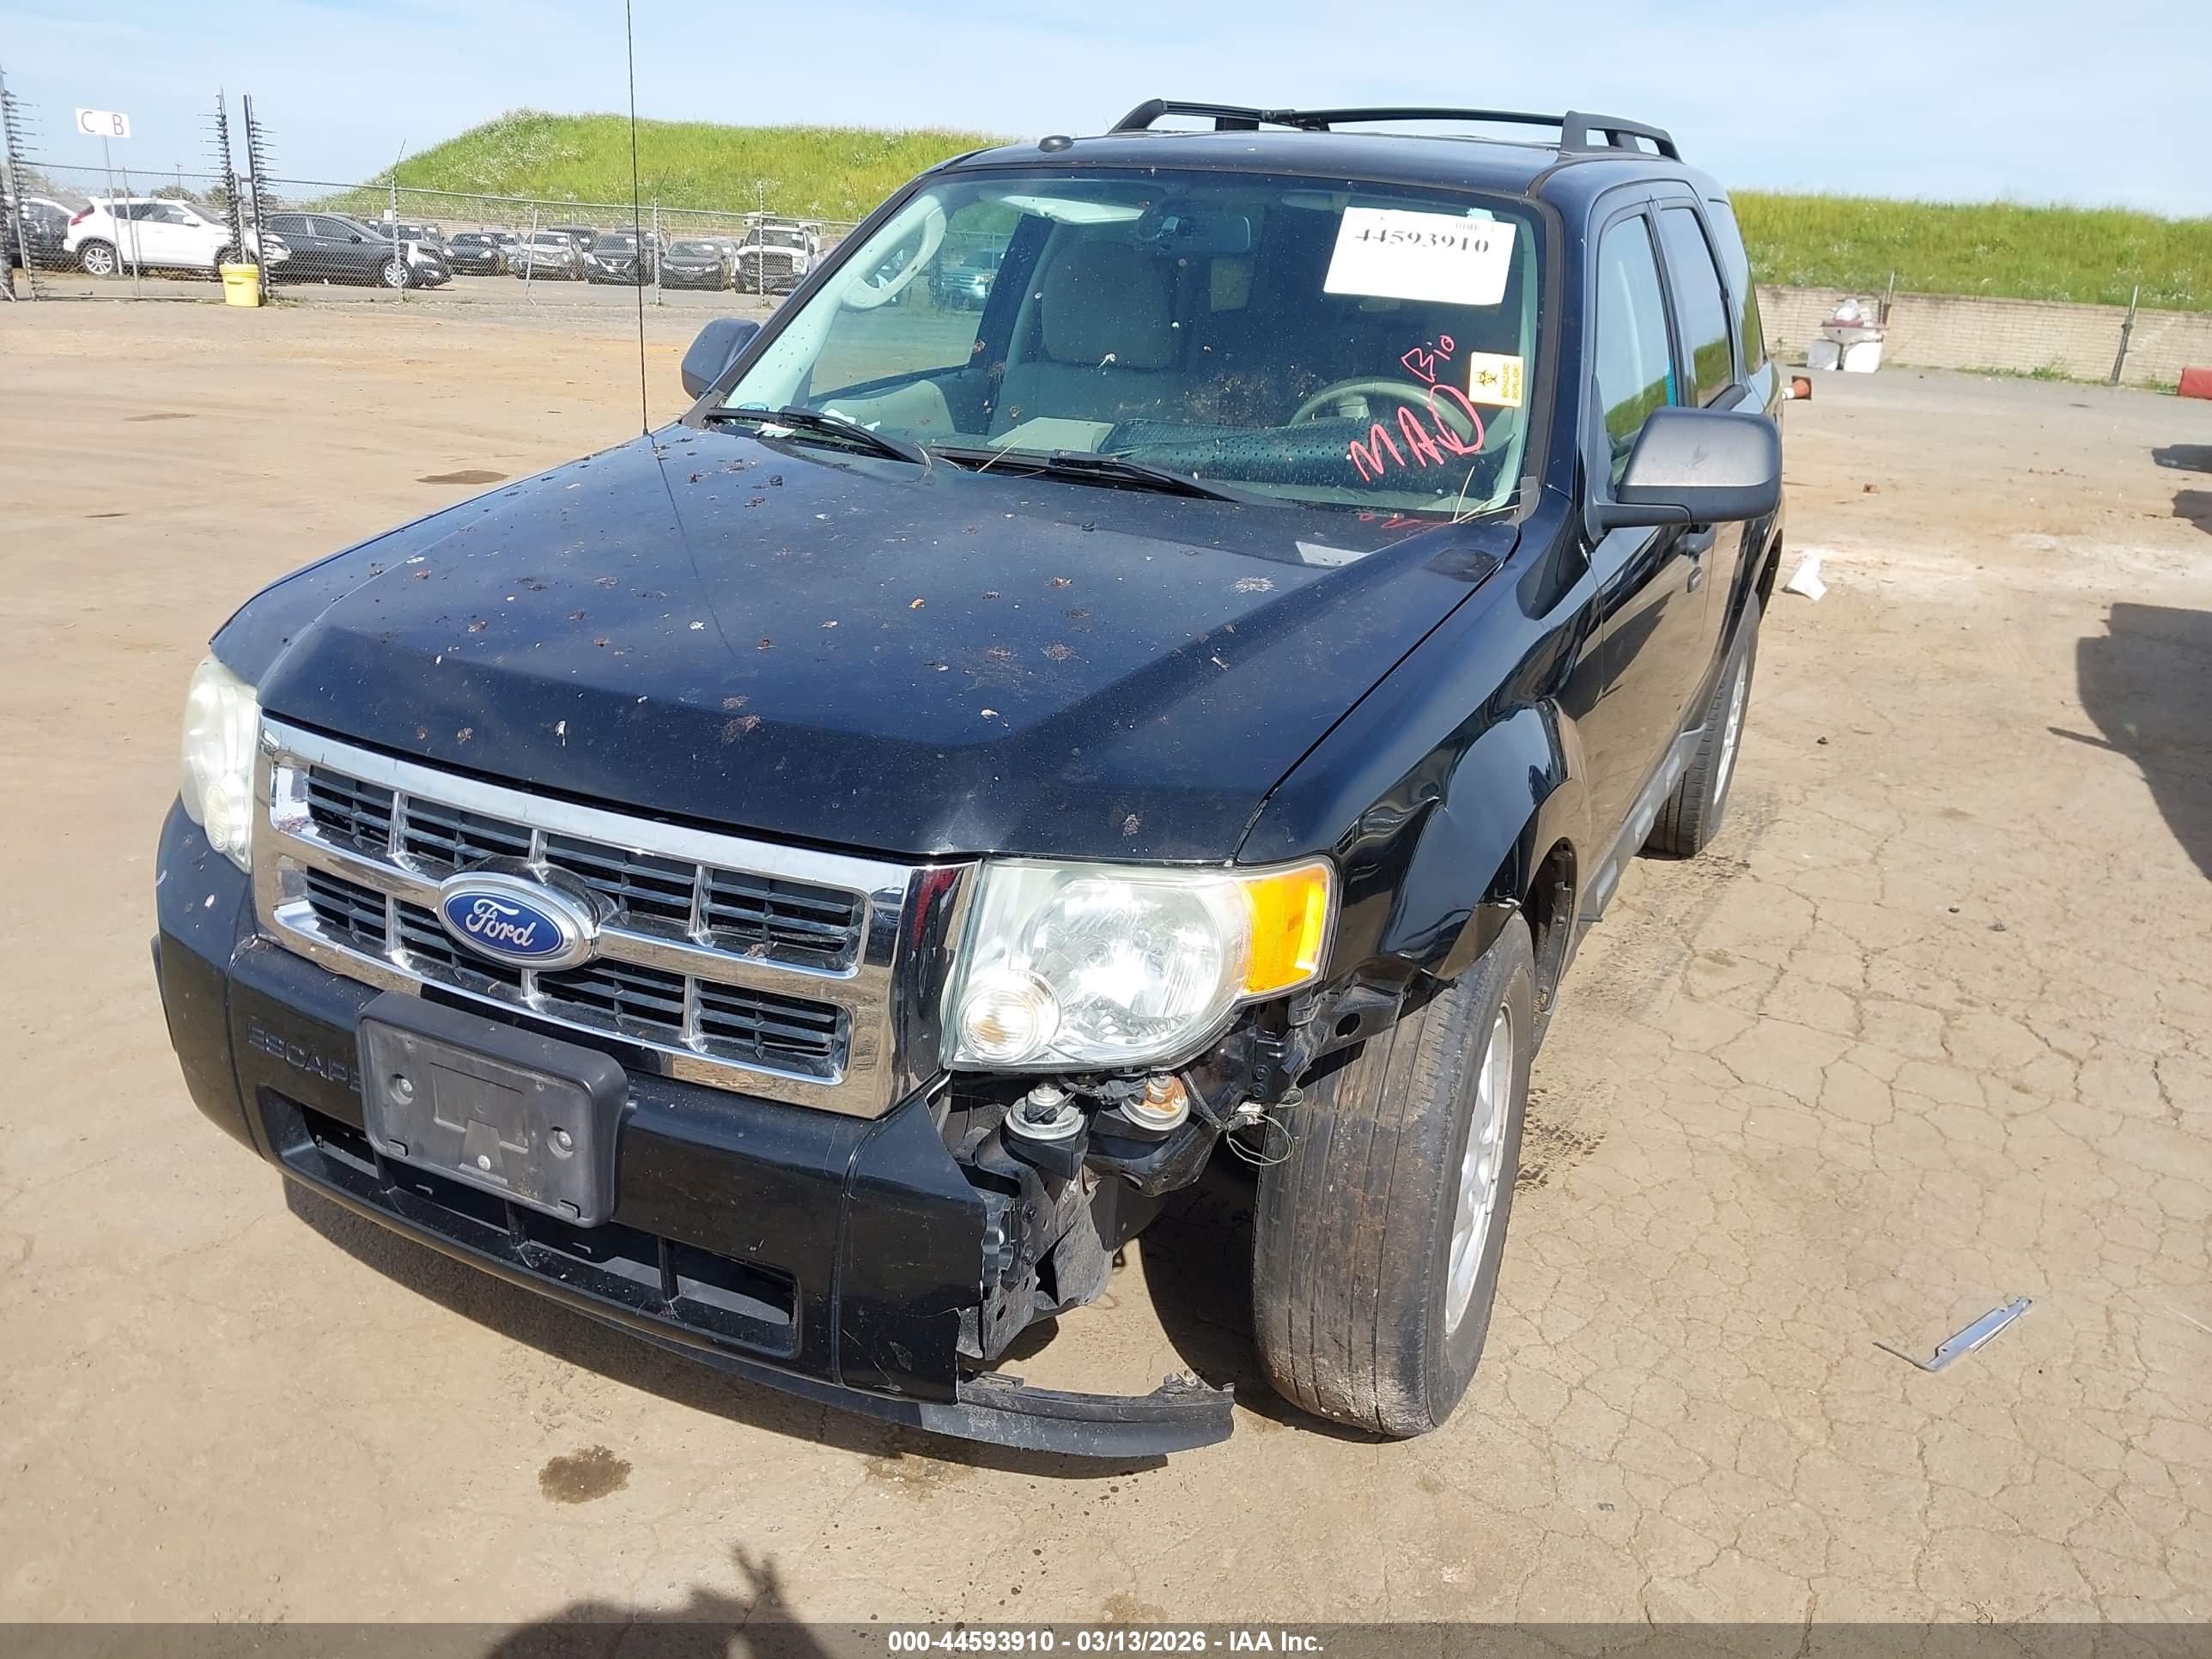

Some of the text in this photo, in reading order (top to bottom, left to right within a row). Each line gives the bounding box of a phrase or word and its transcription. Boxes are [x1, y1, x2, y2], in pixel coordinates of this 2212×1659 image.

[81, 111, 125, 135] C B
[1355, 228, 1490, 253] 44593910
[465, 898, 538, 947] Ford
